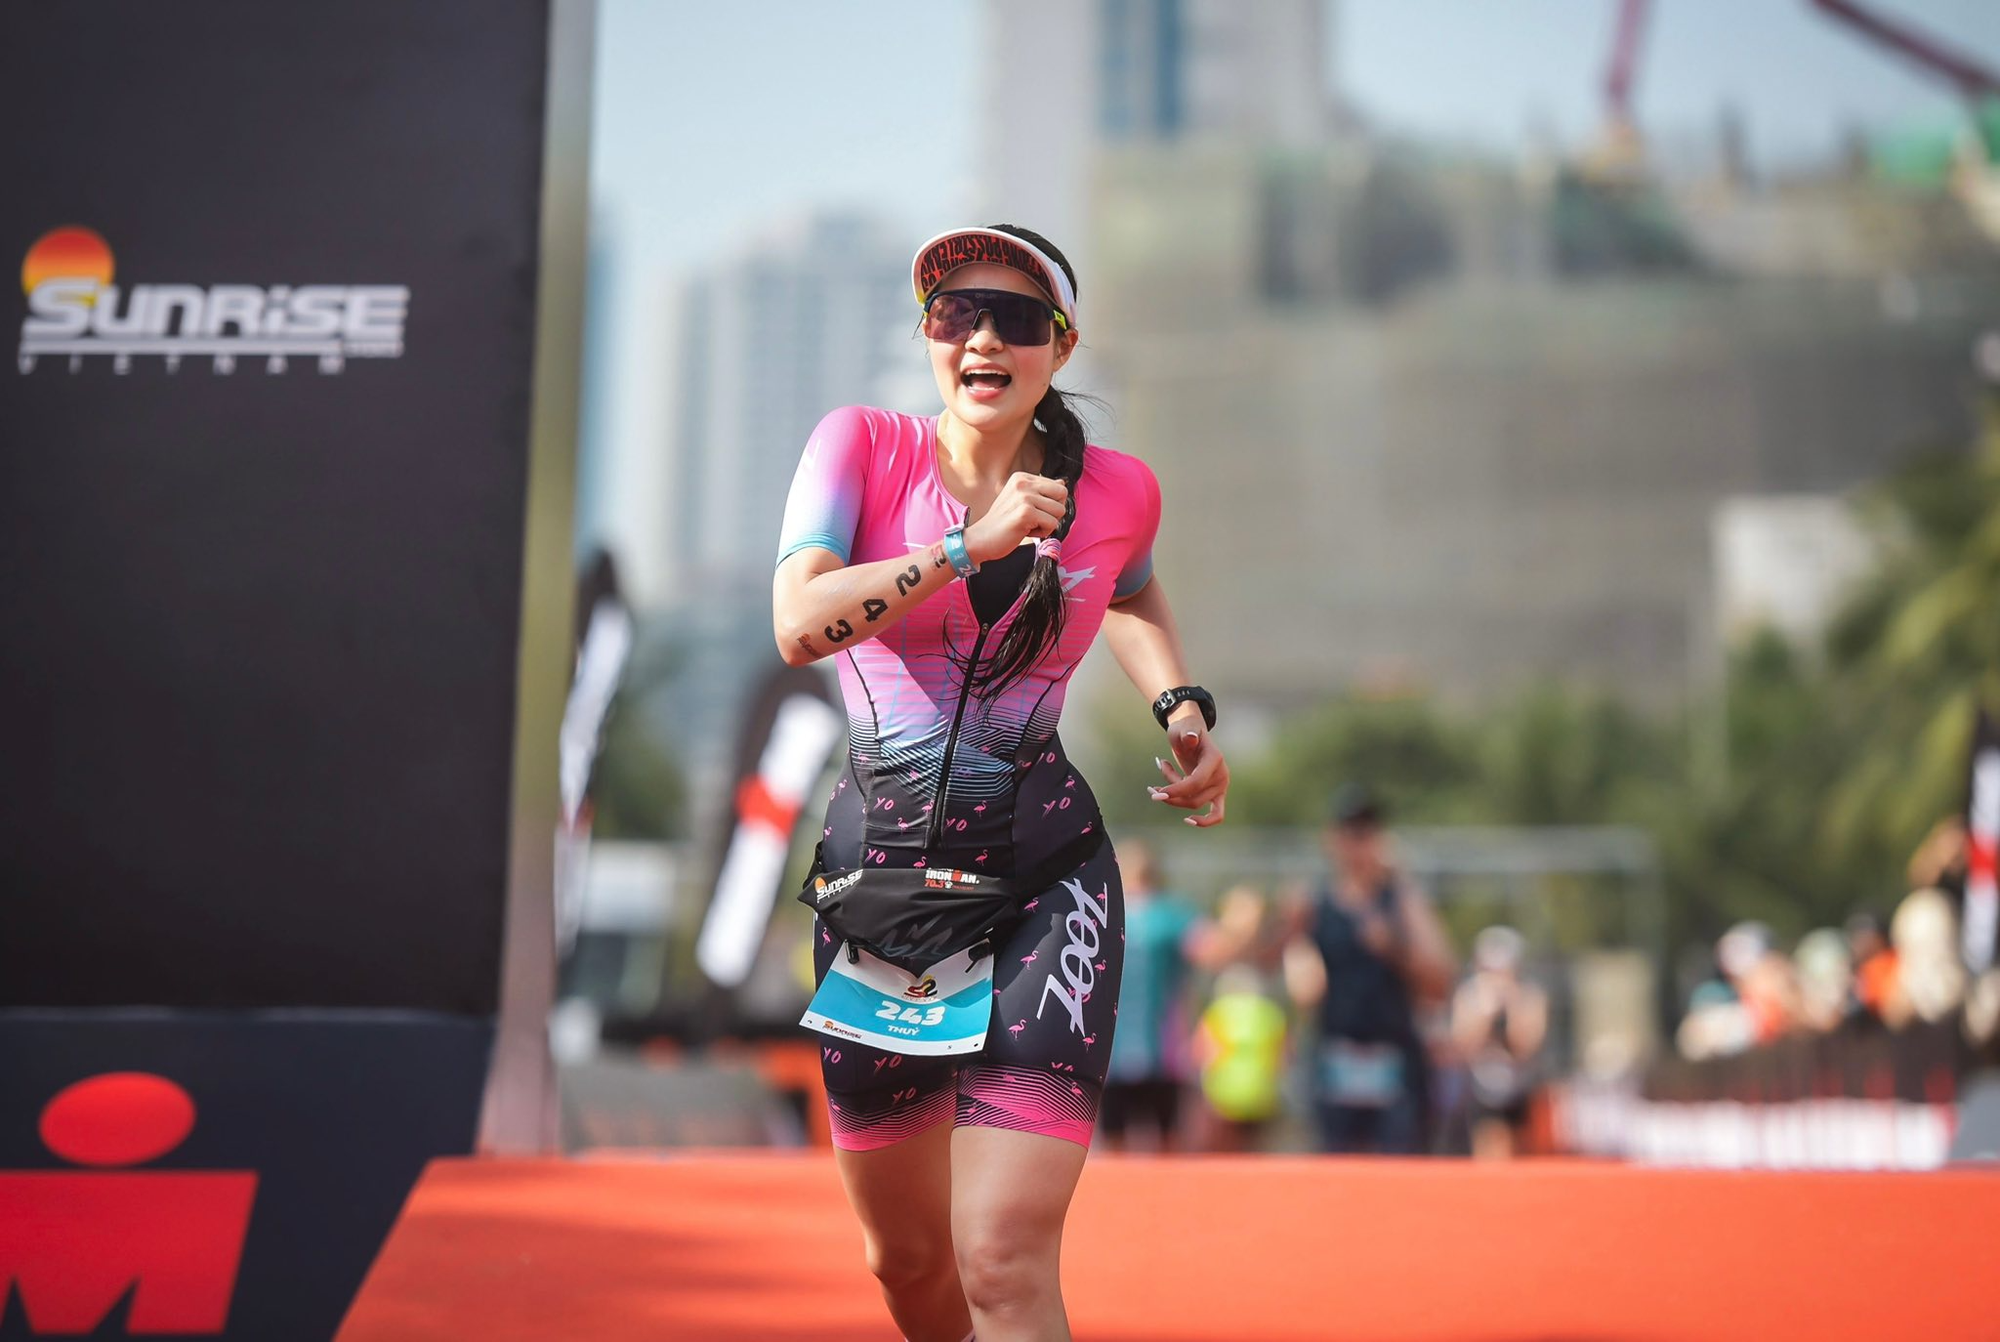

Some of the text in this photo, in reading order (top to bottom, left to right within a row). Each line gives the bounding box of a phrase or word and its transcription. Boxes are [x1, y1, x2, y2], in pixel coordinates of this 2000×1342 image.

[872, 797, 895, 812] YO
[1041, 796, 1071, 819] YO
[944, 817, 968, 832] YO
[863, 848, 887, 865] YO
[875, 1000, 946, 1026] 243
[823, 1047, 842, 1064] YO
[874, 1054, 902, 1072] YO
